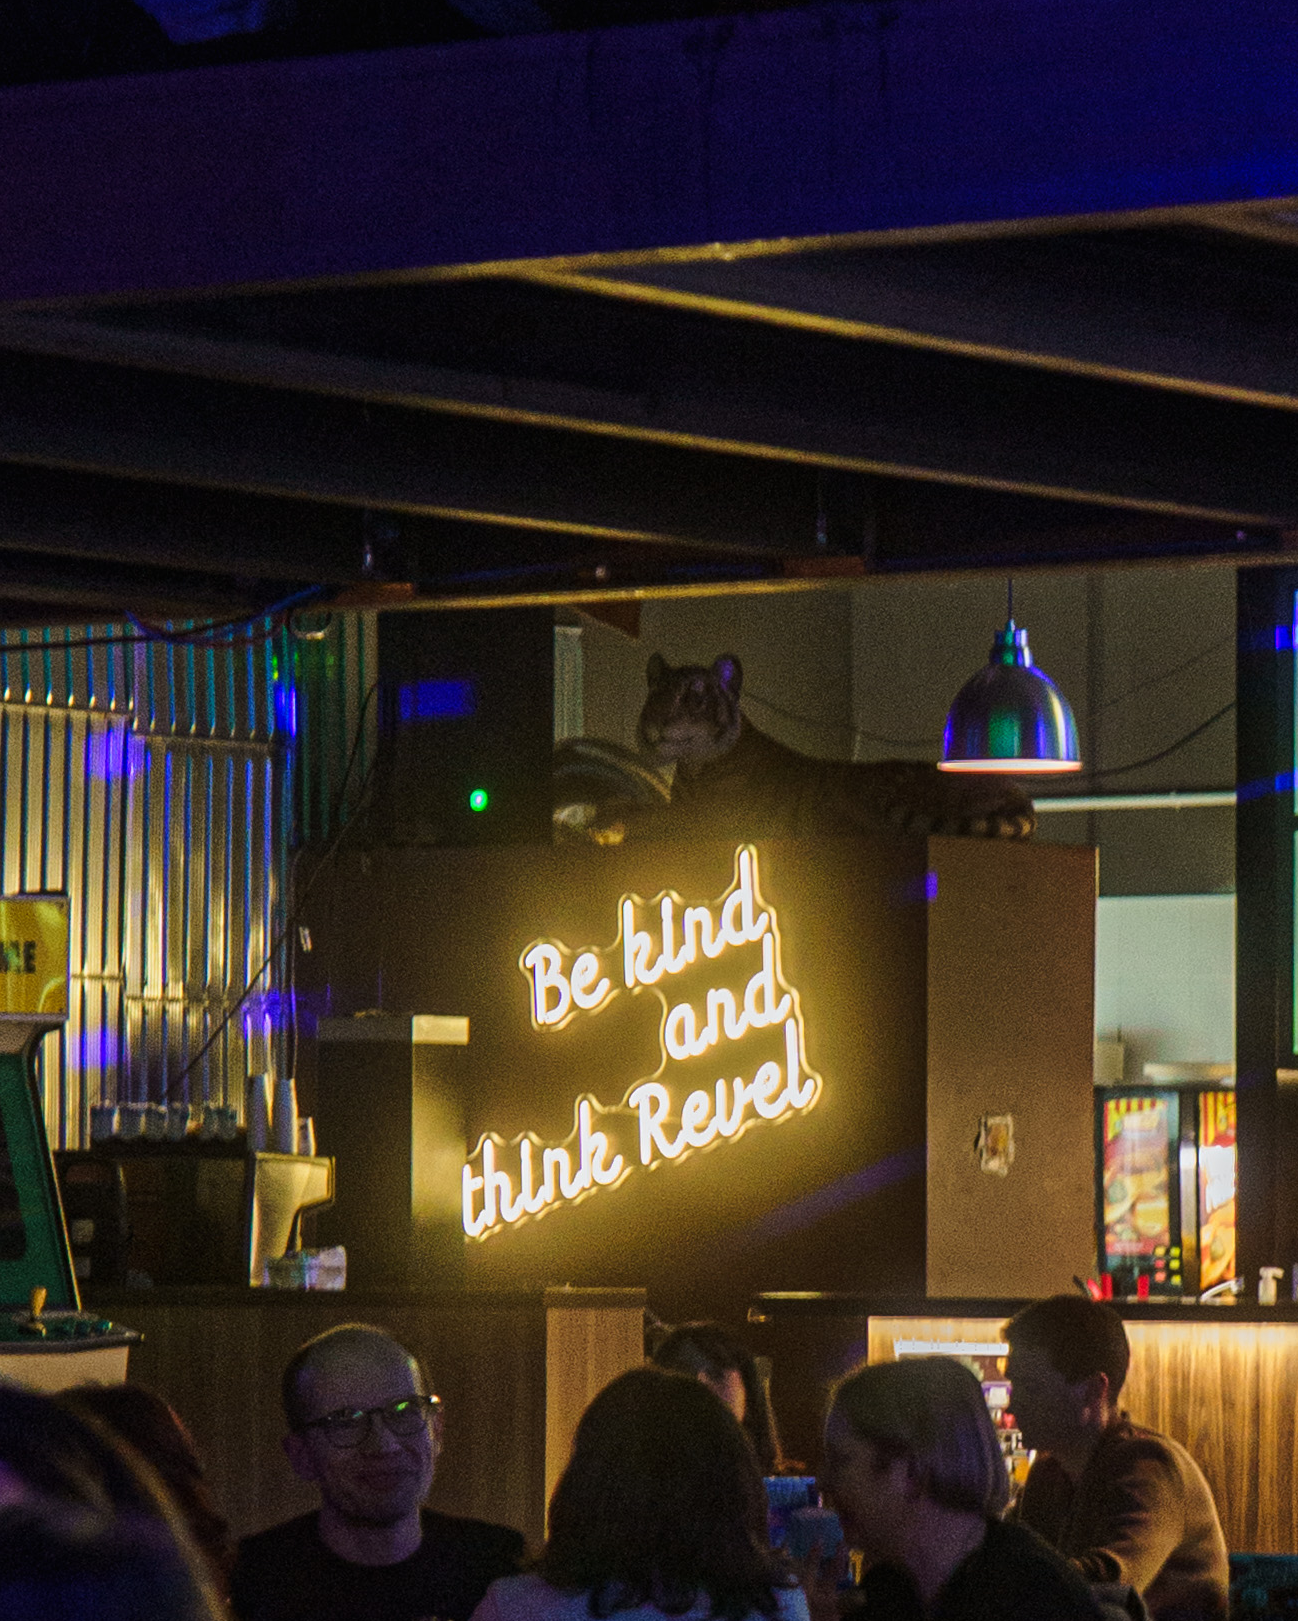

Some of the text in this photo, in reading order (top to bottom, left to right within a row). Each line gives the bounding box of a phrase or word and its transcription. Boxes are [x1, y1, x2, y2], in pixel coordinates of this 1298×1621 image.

[525, 849, 769, 1025] Be kind
[664, 932, 793, 1061] and
[462, 1018, 816, 1238] think Revel
